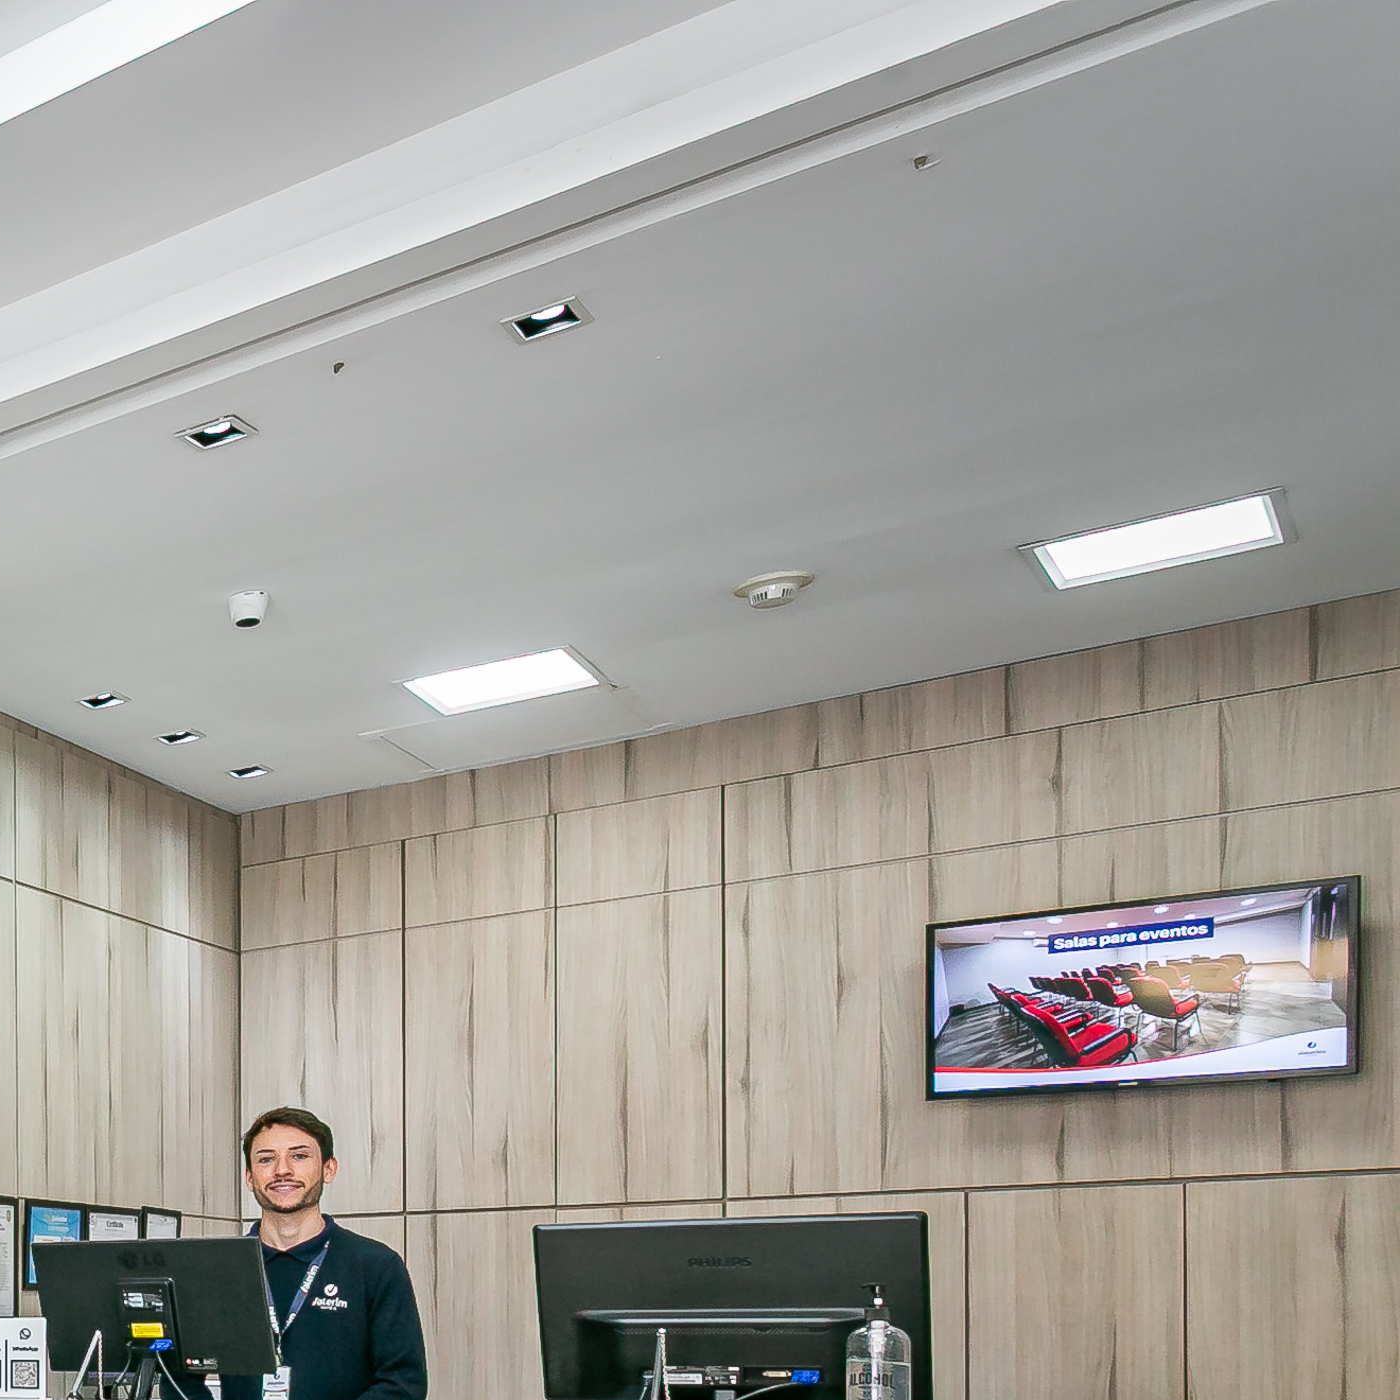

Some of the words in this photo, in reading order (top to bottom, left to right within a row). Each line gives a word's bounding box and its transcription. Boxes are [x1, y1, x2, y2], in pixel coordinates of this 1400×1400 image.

[1053, 935, 1097, 950] Salas
[1099, 931, 1137, 947] para
[1138, 924, 1209, 941] eventos
[686, 1256, 753, 1268] PHILIPS
